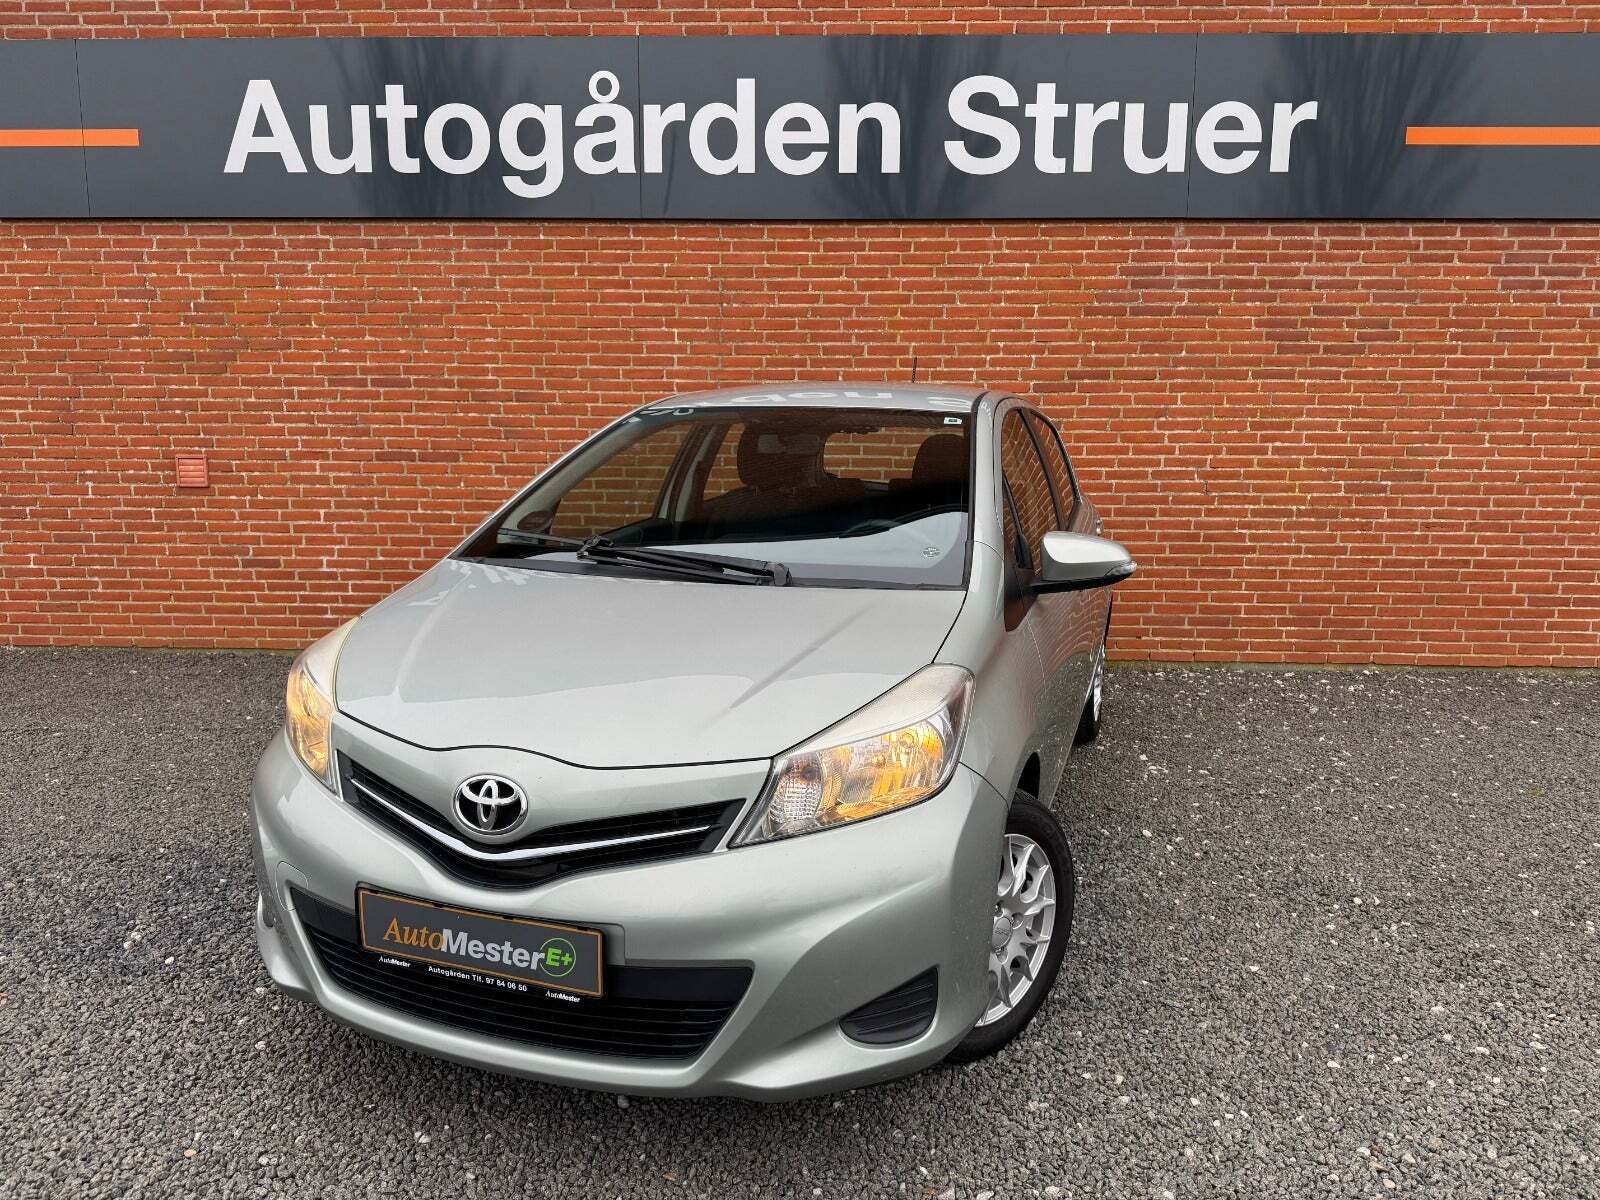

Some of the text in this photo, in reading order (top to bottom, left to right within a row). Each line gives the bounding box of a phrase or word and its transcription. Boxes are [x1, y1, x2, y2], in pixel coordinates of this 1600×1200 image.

[224, 71, 1318, 198] Autogården Struer
[383, 917, 545, 970] AutoMester
[428, 965, 470, 980] Autogården
[485, 977, 495, 986] 97
[496, 979, 506, 987] 84
[518, 984, 528, 993] 50
[545, 989, 581, 1003] AutoMester
